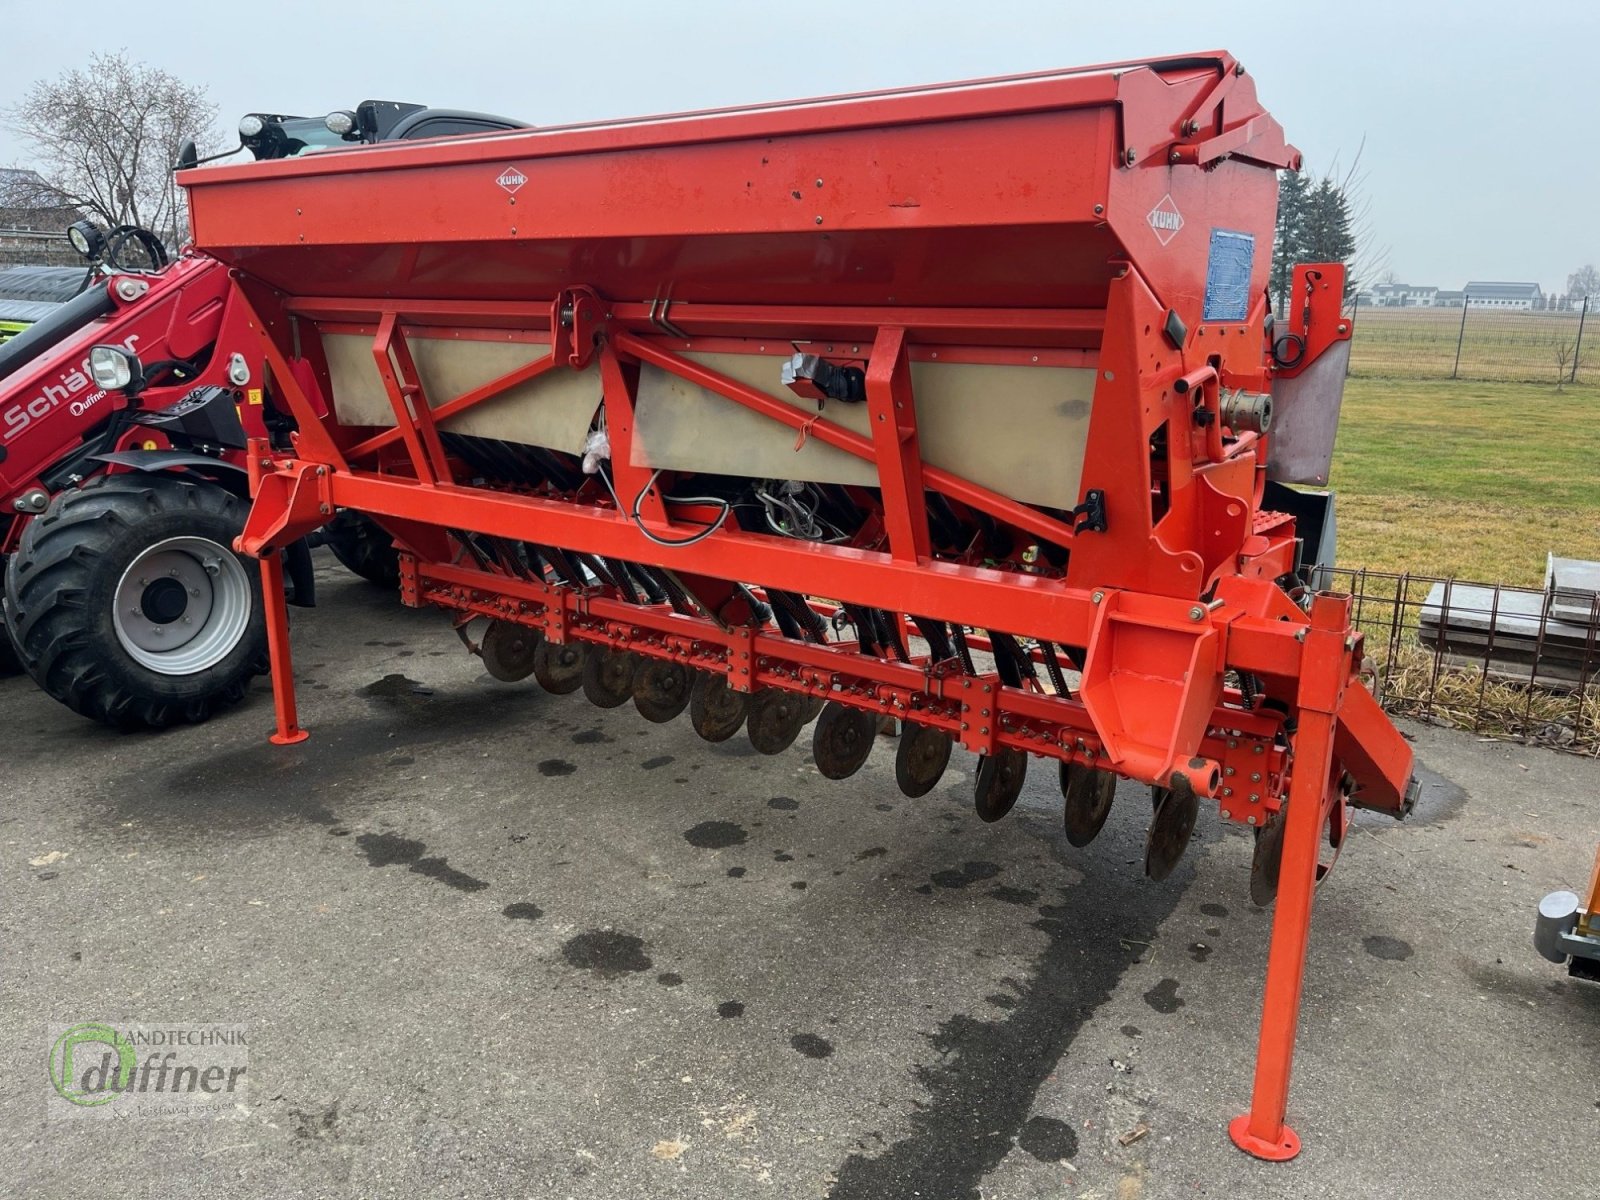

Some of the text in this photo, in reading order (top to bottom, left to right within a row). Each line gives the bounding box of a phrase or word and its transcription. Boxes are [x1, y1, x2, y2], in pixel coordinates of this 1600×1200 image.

[500, 175, 524, 185] KUHN
[1152, 210, 1180, 230] KUHN
[3, 334, 139, 439] Schäfr
